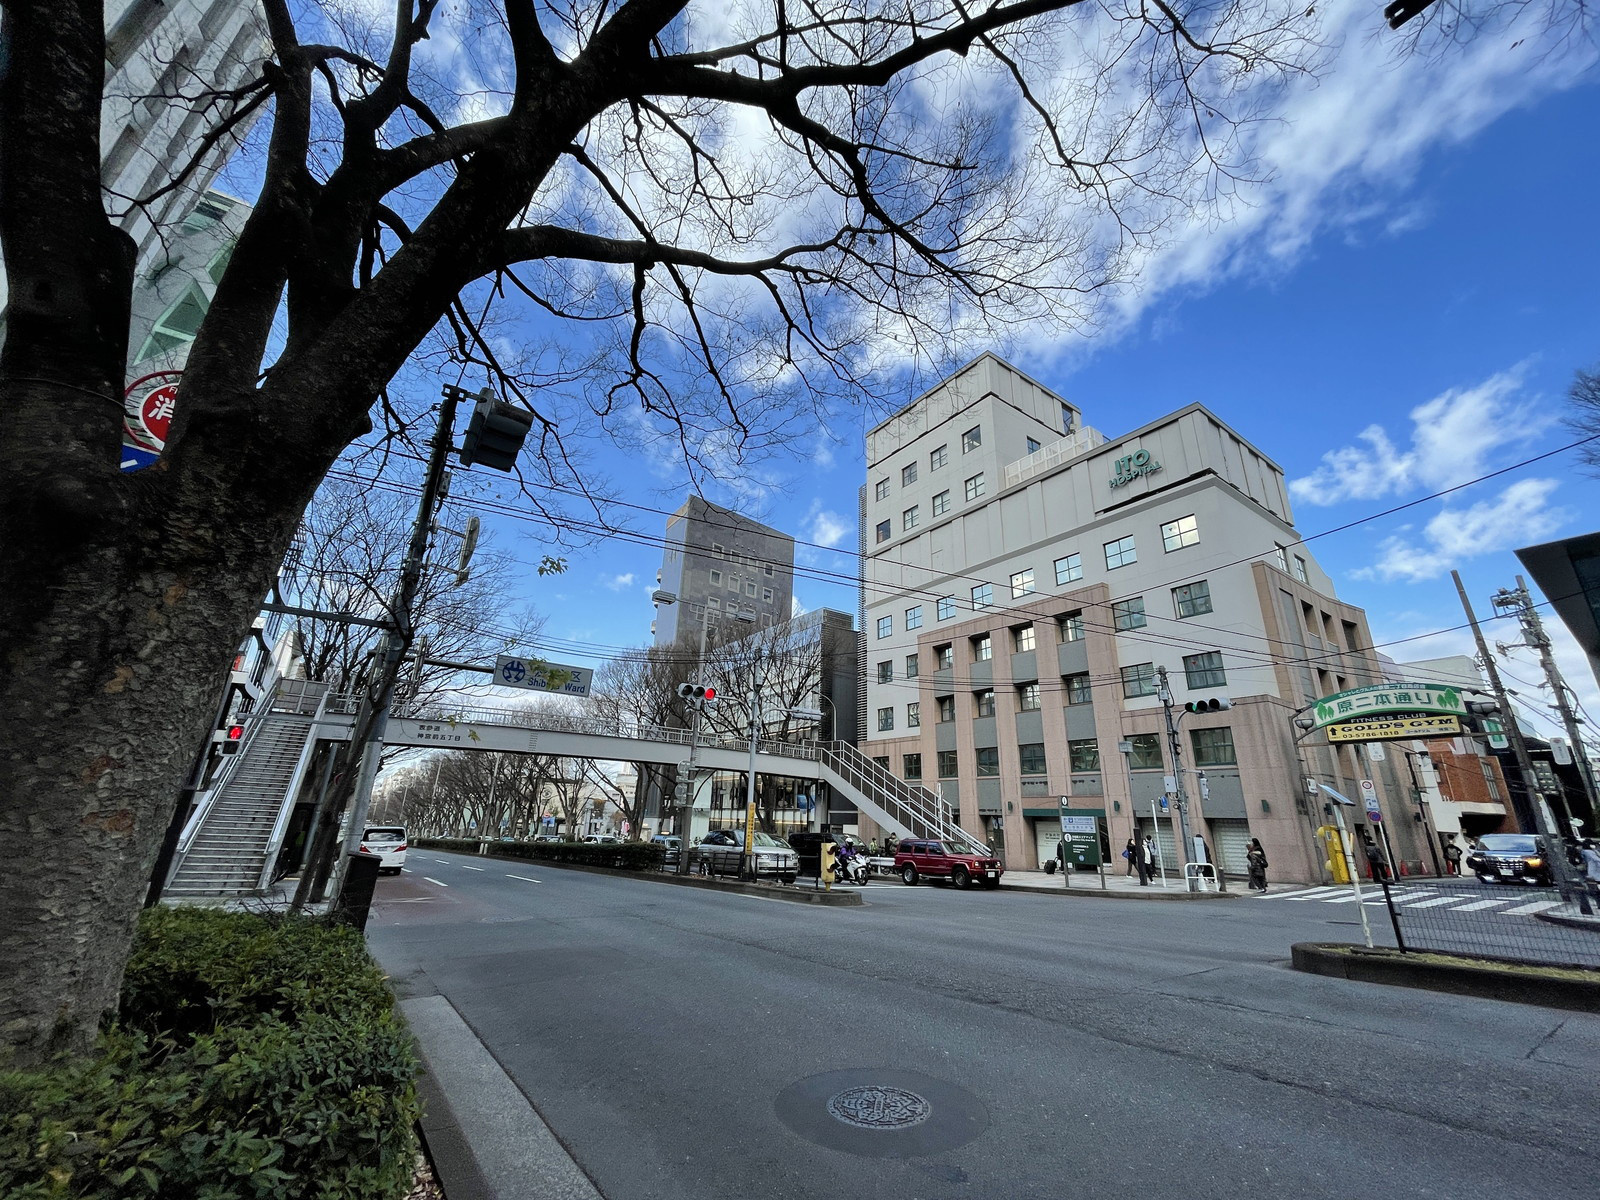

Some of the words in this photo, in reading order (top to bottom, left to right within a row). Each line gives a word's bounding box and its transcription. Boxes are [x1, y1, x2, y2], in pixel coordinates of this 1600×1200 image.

[1115, 449, 1150, 475] ITO
[1109, 461, 1162, 488] HOSPITAL
[527, 676, 560, 691] Shib
[565, 683, 585, 693] Ward
[1337, 692, 1433, 712] 原二本通り
[1341, 722, 1404, 733] GOLD'S
[1410, 718, 1453, 728] GYM
[1351, 715, 1393, 723] FITNESS
[417, 733, 461, 741] 神宮前五丁目
